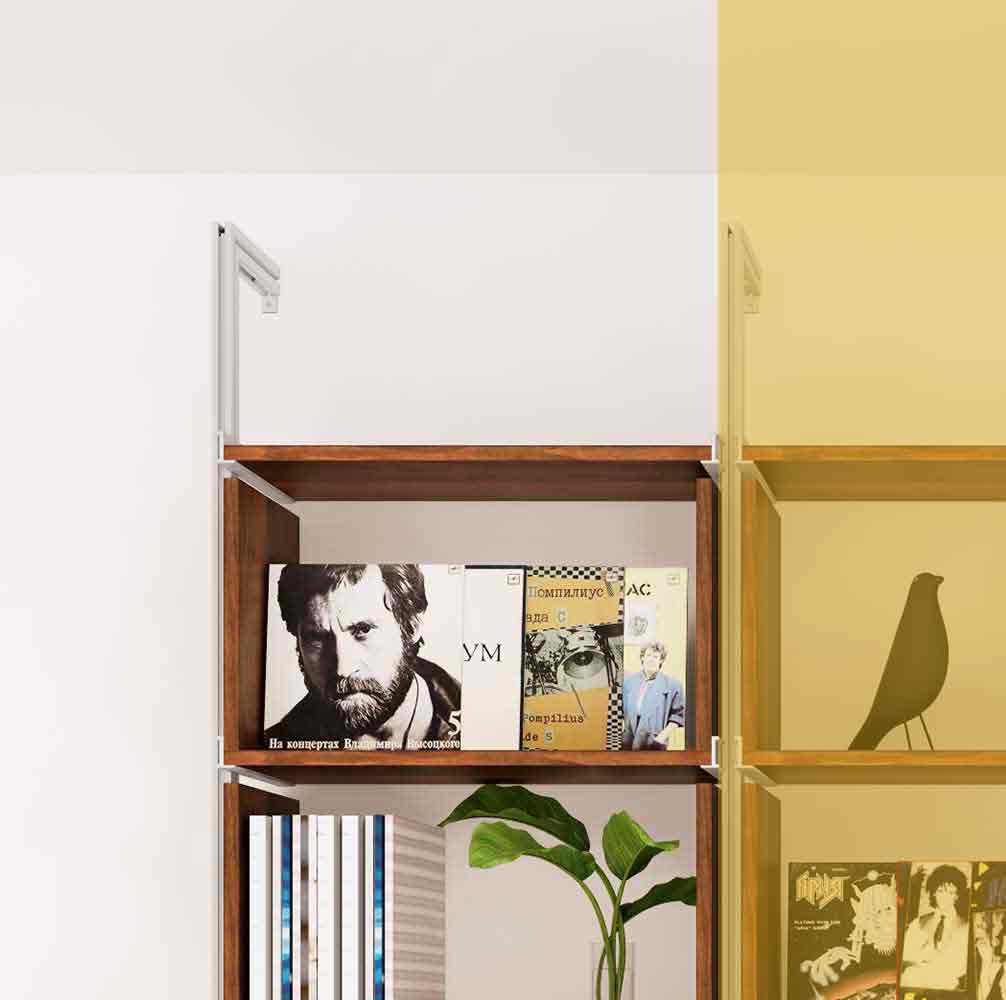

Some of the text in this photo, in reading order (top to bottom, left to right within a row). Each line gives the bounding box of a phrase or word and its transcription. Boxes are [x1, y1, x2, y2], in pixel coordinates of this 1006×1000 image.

[528, 586, 604, 600] Помпилиус
[462, 643, 503, 662] УМ
[269, 738, 283, 749] На
[287, 740, 339, 751] концертах
